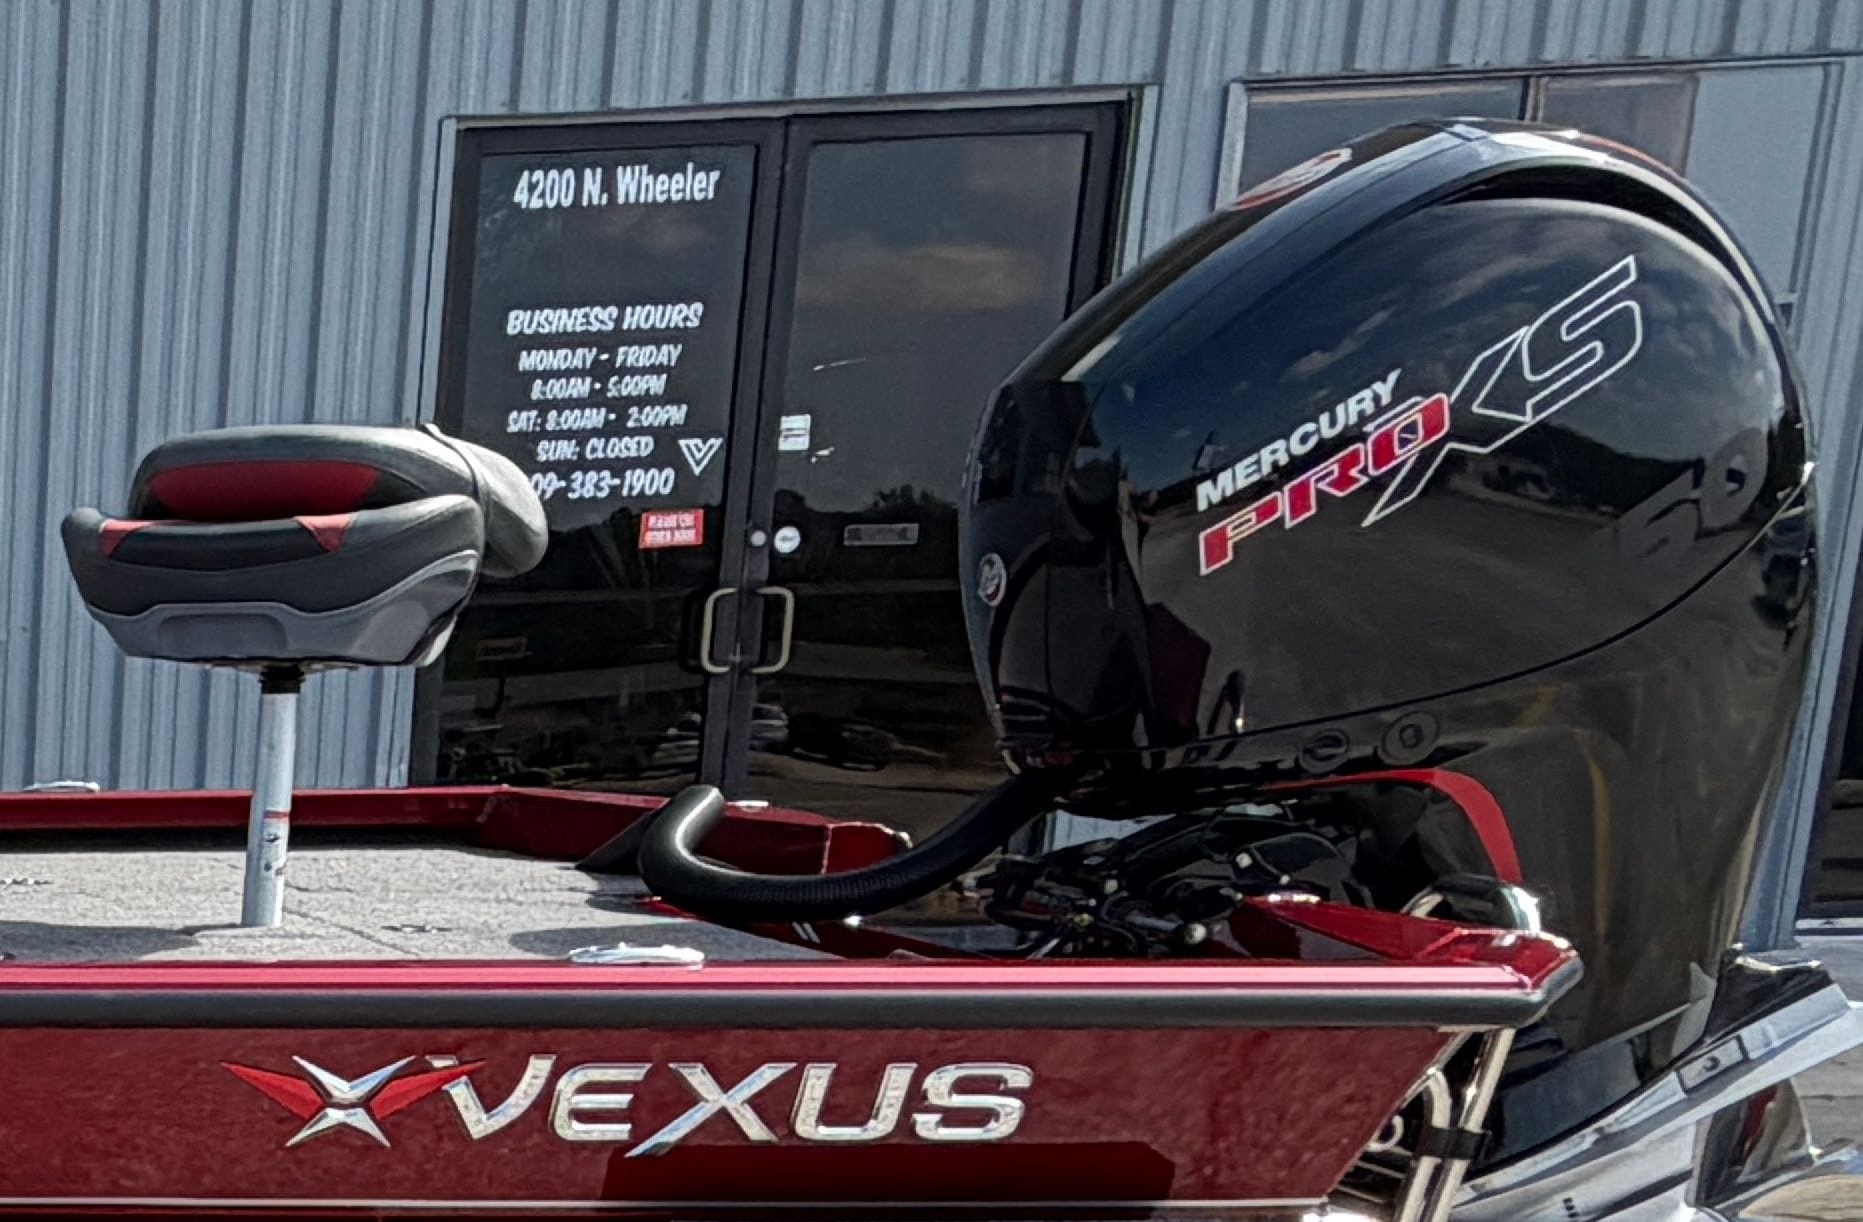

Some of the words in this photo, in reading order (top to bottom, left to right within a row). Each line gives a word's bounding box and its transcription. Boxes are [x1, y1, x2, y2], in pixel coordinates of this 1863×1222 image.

[513, 168, 575, 209] 4200
[581, 166, 608, 207] N.
[616, 161, 721, 205] Wheeler
[506, 306, 619, 336] BUSINESS
[621, 302, 704, 331] HOURS
[518, 347, 597, 372] MONDAY
[615, 343, 683, 368] FRIDAY
[530, 376, 592, 400] 8:00AM
[606, 373, 668, 398] 5:00PM
[506, 409, 542, 433] SAT:
[545, 407, 607, 431] 8:00AM
[625, 403, 688, 429] 2:00PM
[1199, 392, 1451, 577] PRO
[1361, 254, 1643, 528] XS
[536, 439, 580, 462] SUN:
[585, 435, 655, 460] CLOSED
[1196, 368, 1402, 512] MERCURY
[529, 467, 675, 500] 09-383-1900
[424, 1054, 1035, 1158] VEXUS
